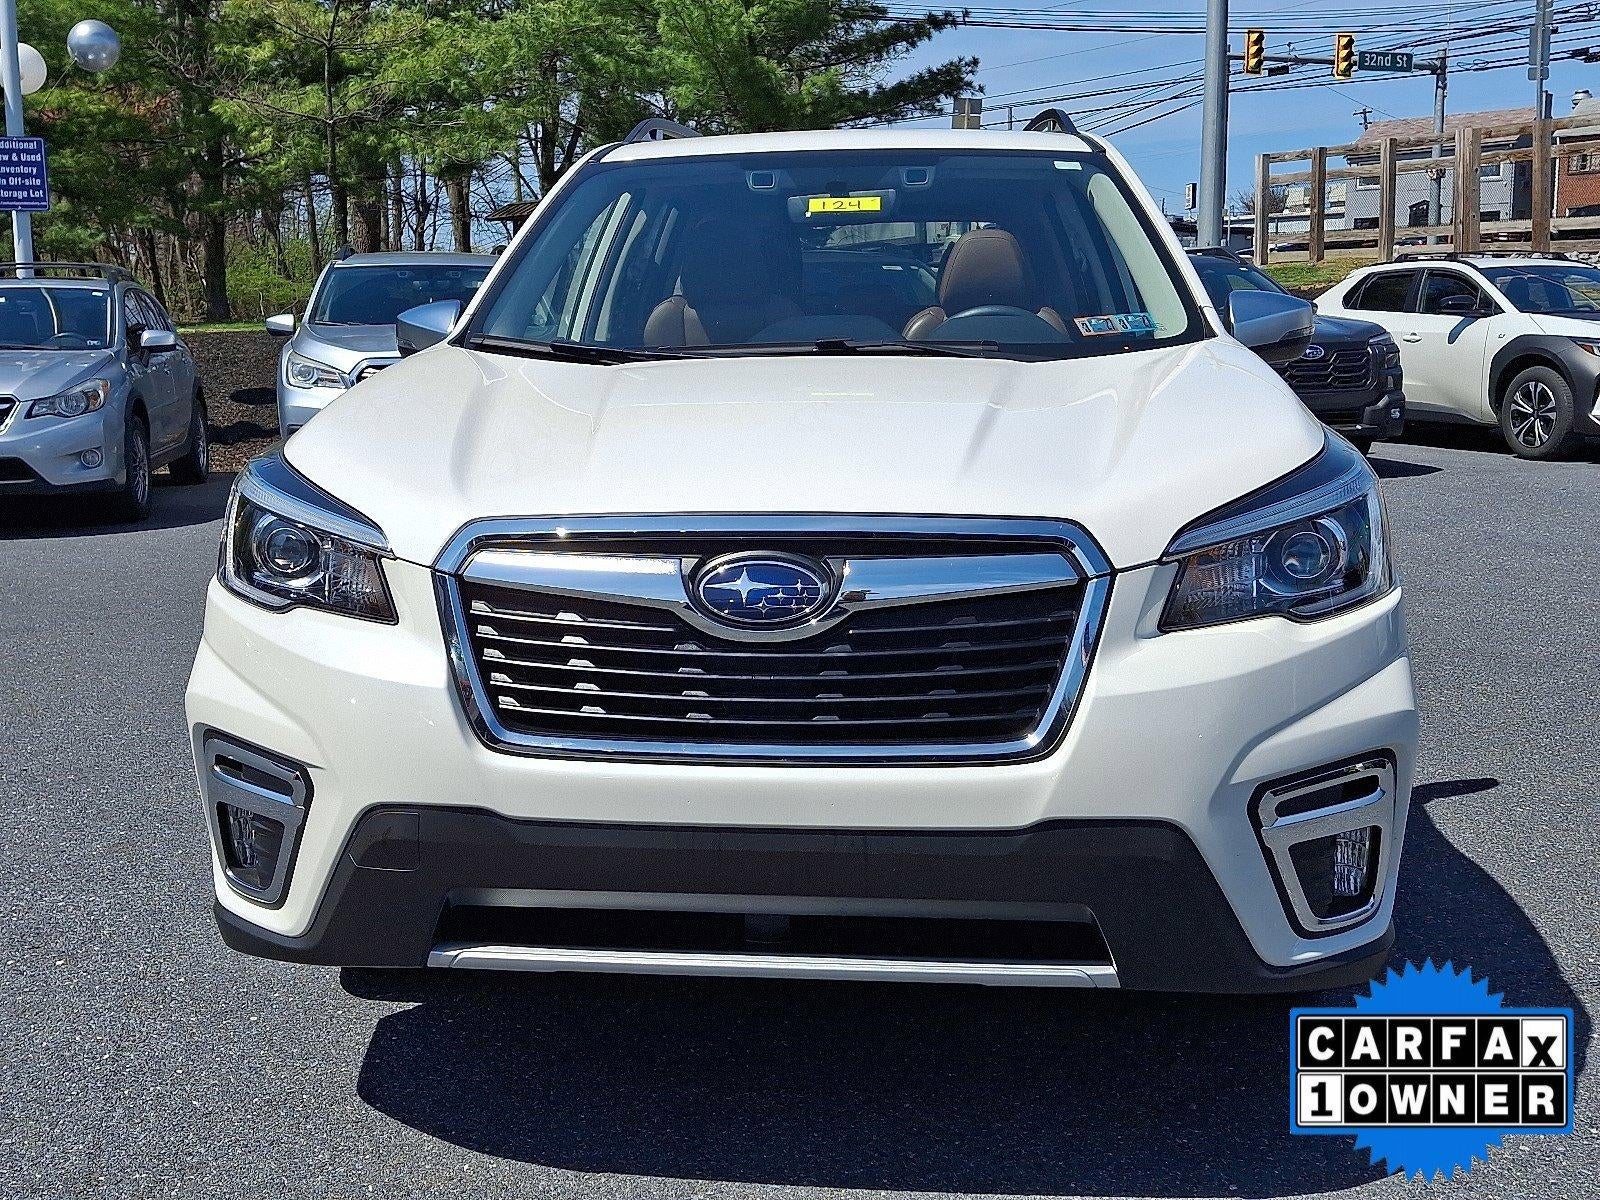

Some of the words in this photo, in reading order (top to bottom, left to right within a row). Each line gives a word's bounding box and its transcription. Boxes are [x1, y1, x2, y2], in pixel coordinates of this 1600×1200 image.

[1364, 53, 1391, 67] 32nd
[1396, 54, 1407, 68] St
[0, 140, 37, 149] dditional
[12, 152, 18, 161] &
[20, 152, 41, 162] Used
[0, 165, 37, 175] nventory
[9, 176, 41, 186] Off-site
[0, 189, 28, 199] torage
[30, 189, 44, 198] Lot
[822, 199, 861, 210] 124
